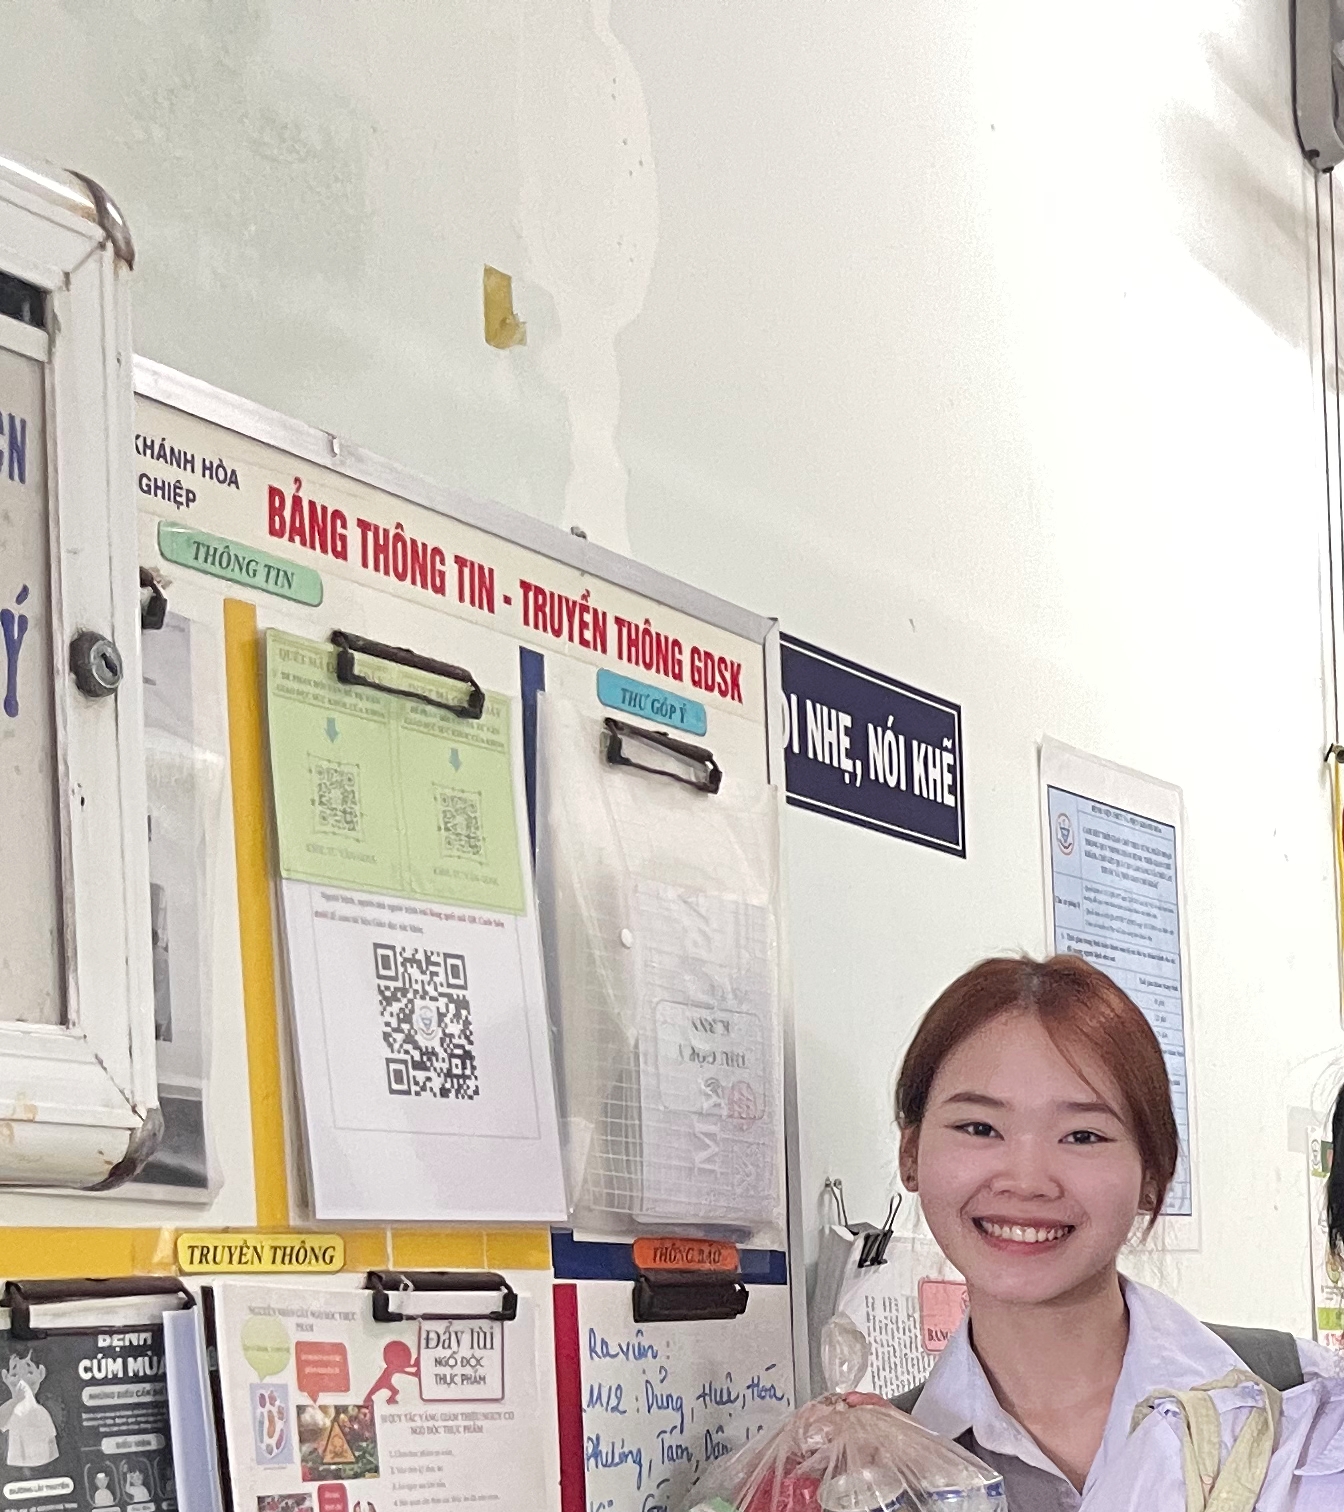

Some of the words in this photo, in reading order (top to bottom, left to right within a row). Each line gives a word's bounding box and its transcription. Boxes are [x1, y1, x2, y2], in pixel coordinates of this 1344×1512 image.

[201, 457, 240, 490] HÒA
[192, 540, 258, 584] THÔNG
[263, 561, 294, 591] TIN
[268, 478, 348, 562] BẢNG
[356, 521, 447, 606] THÔNG
[454, 555, 495, 616] TIN
[520, 578, 608, 655] TRUYỀN
[614, 618, 683, 675] THÔNG
[689, 645, 743, 704] GDSK
[620, 686, 651, 712] THƯ
[806, 699, 862, 788] NHẸ,
[867, 715, 906, 791] NÓI
[912, 737, 956, 808] KHẼ
[187, 1239, 264, 1266] TRUYỀN
[270, 1240, 336, 1266] THÔNG
[424, 1321, 464, 1354] Đẩy
[470, 1325, 494, 1350] lùi
[79, 1353, 123, 1380] CÚM
